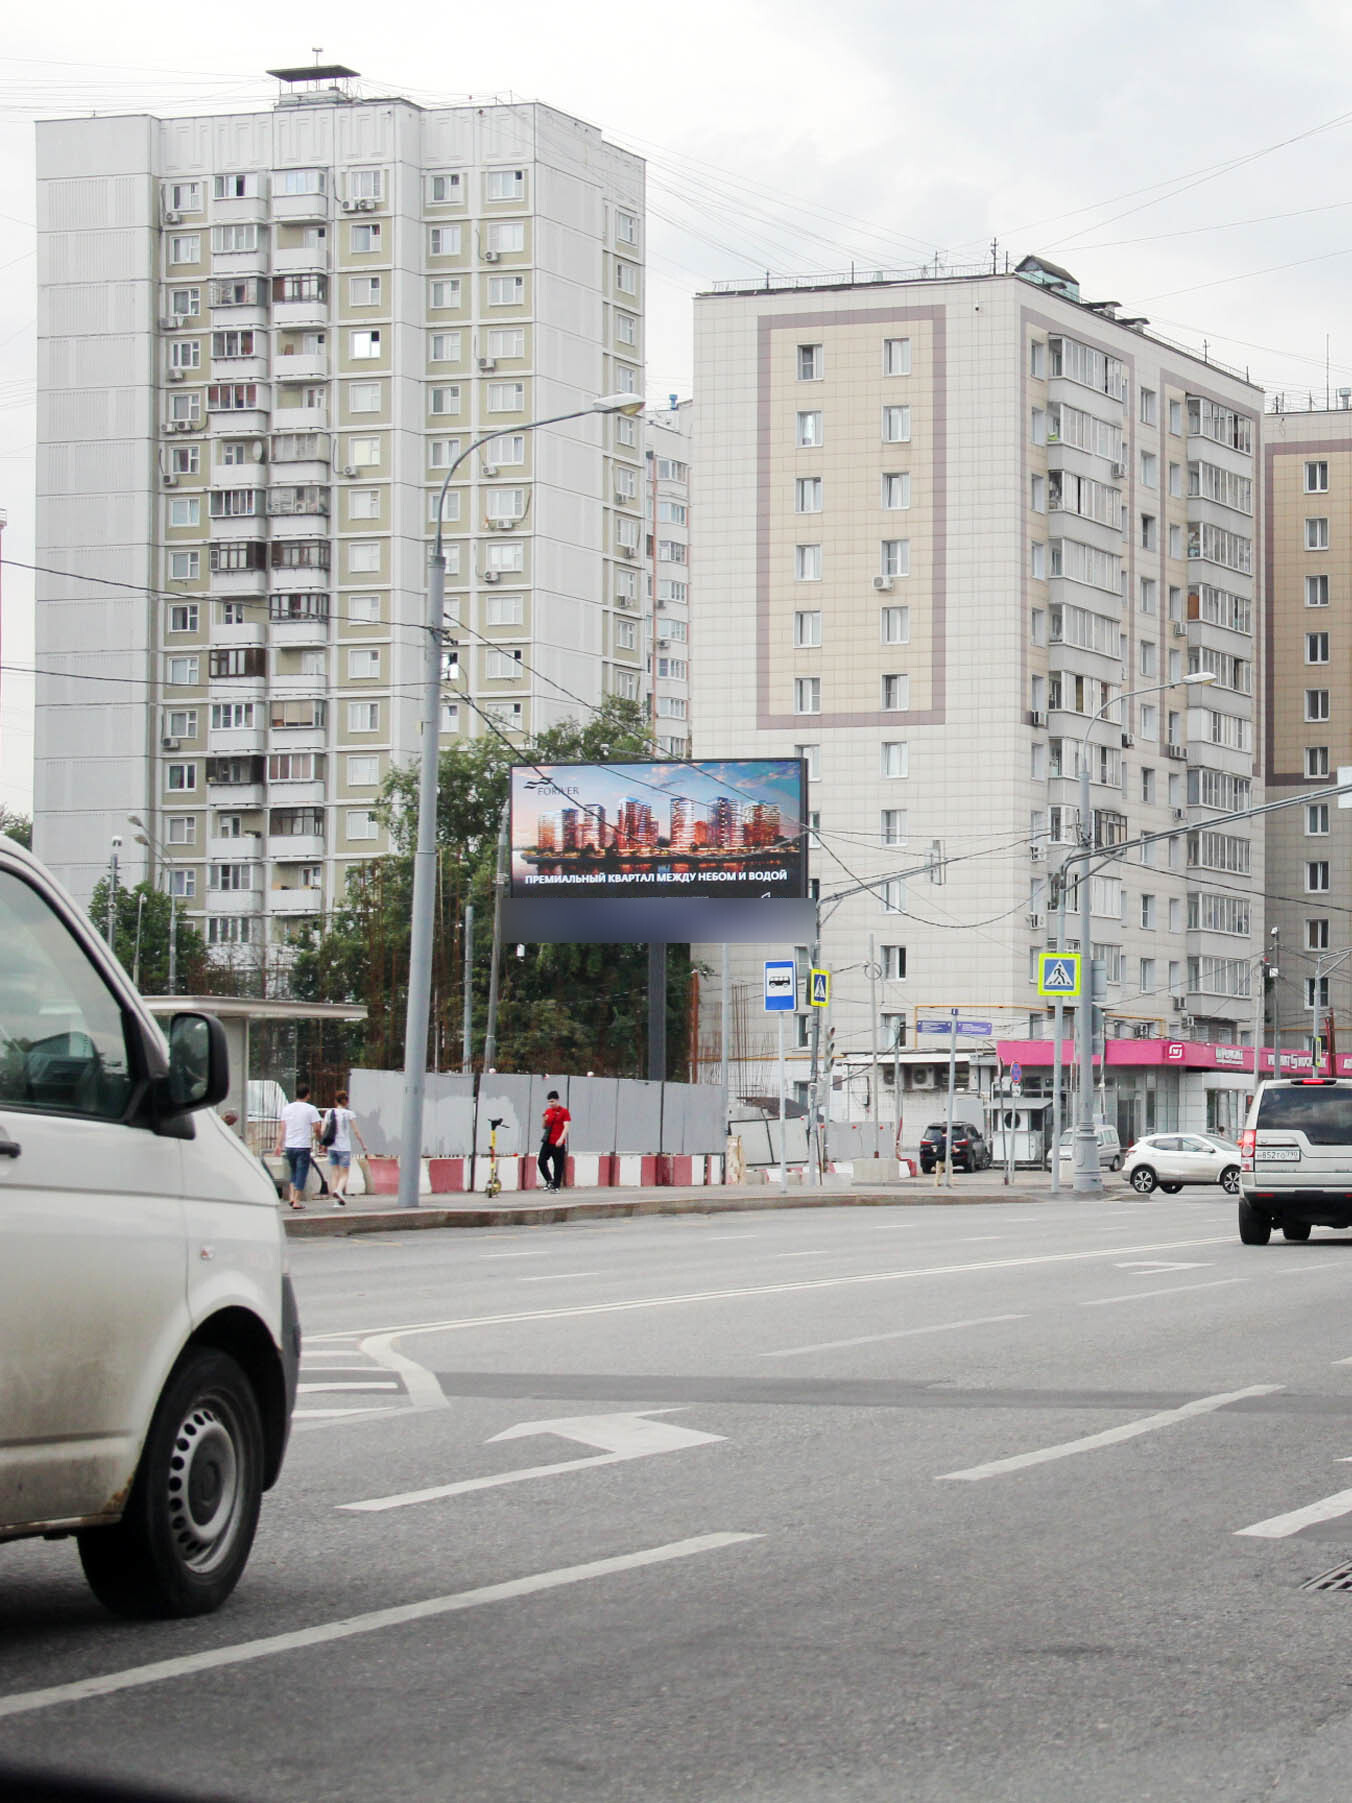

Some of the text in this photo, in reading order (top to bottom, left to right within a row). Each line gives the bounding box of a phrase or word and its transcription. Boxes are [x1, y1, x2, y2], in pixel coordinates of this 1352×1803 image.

[524, 869, 788, 884] ПРЕМИАЛЬНЫЙ КВАРТАЛ МЕЖДУ НЕБОМ И ВОДОЙ
